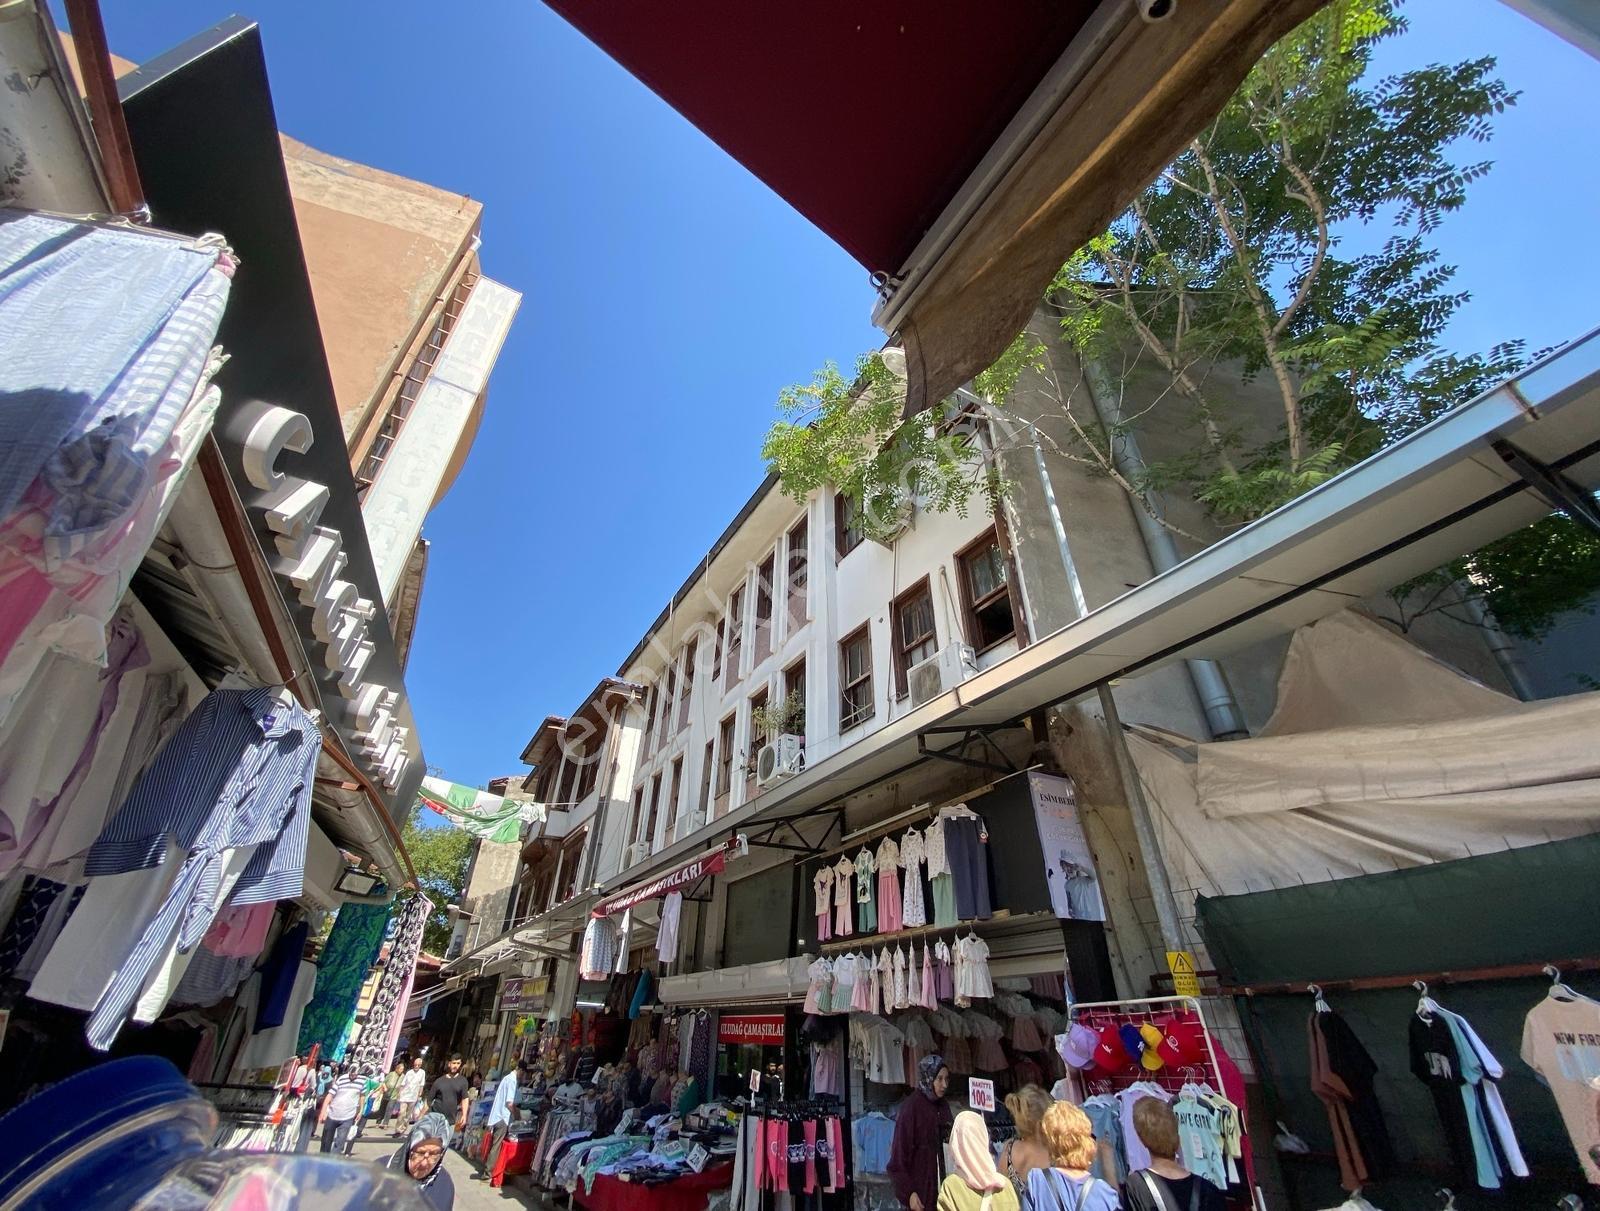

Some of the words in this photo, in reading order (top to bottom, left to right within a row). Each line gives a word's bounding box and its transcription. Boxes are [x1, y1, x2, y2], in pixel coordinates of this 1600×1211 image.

[720, 1021, 743, 1035] ULUDAĞ
[1553, 1032, 1576, 1045] NEW
[972, 1089, 986, 1107] 100
